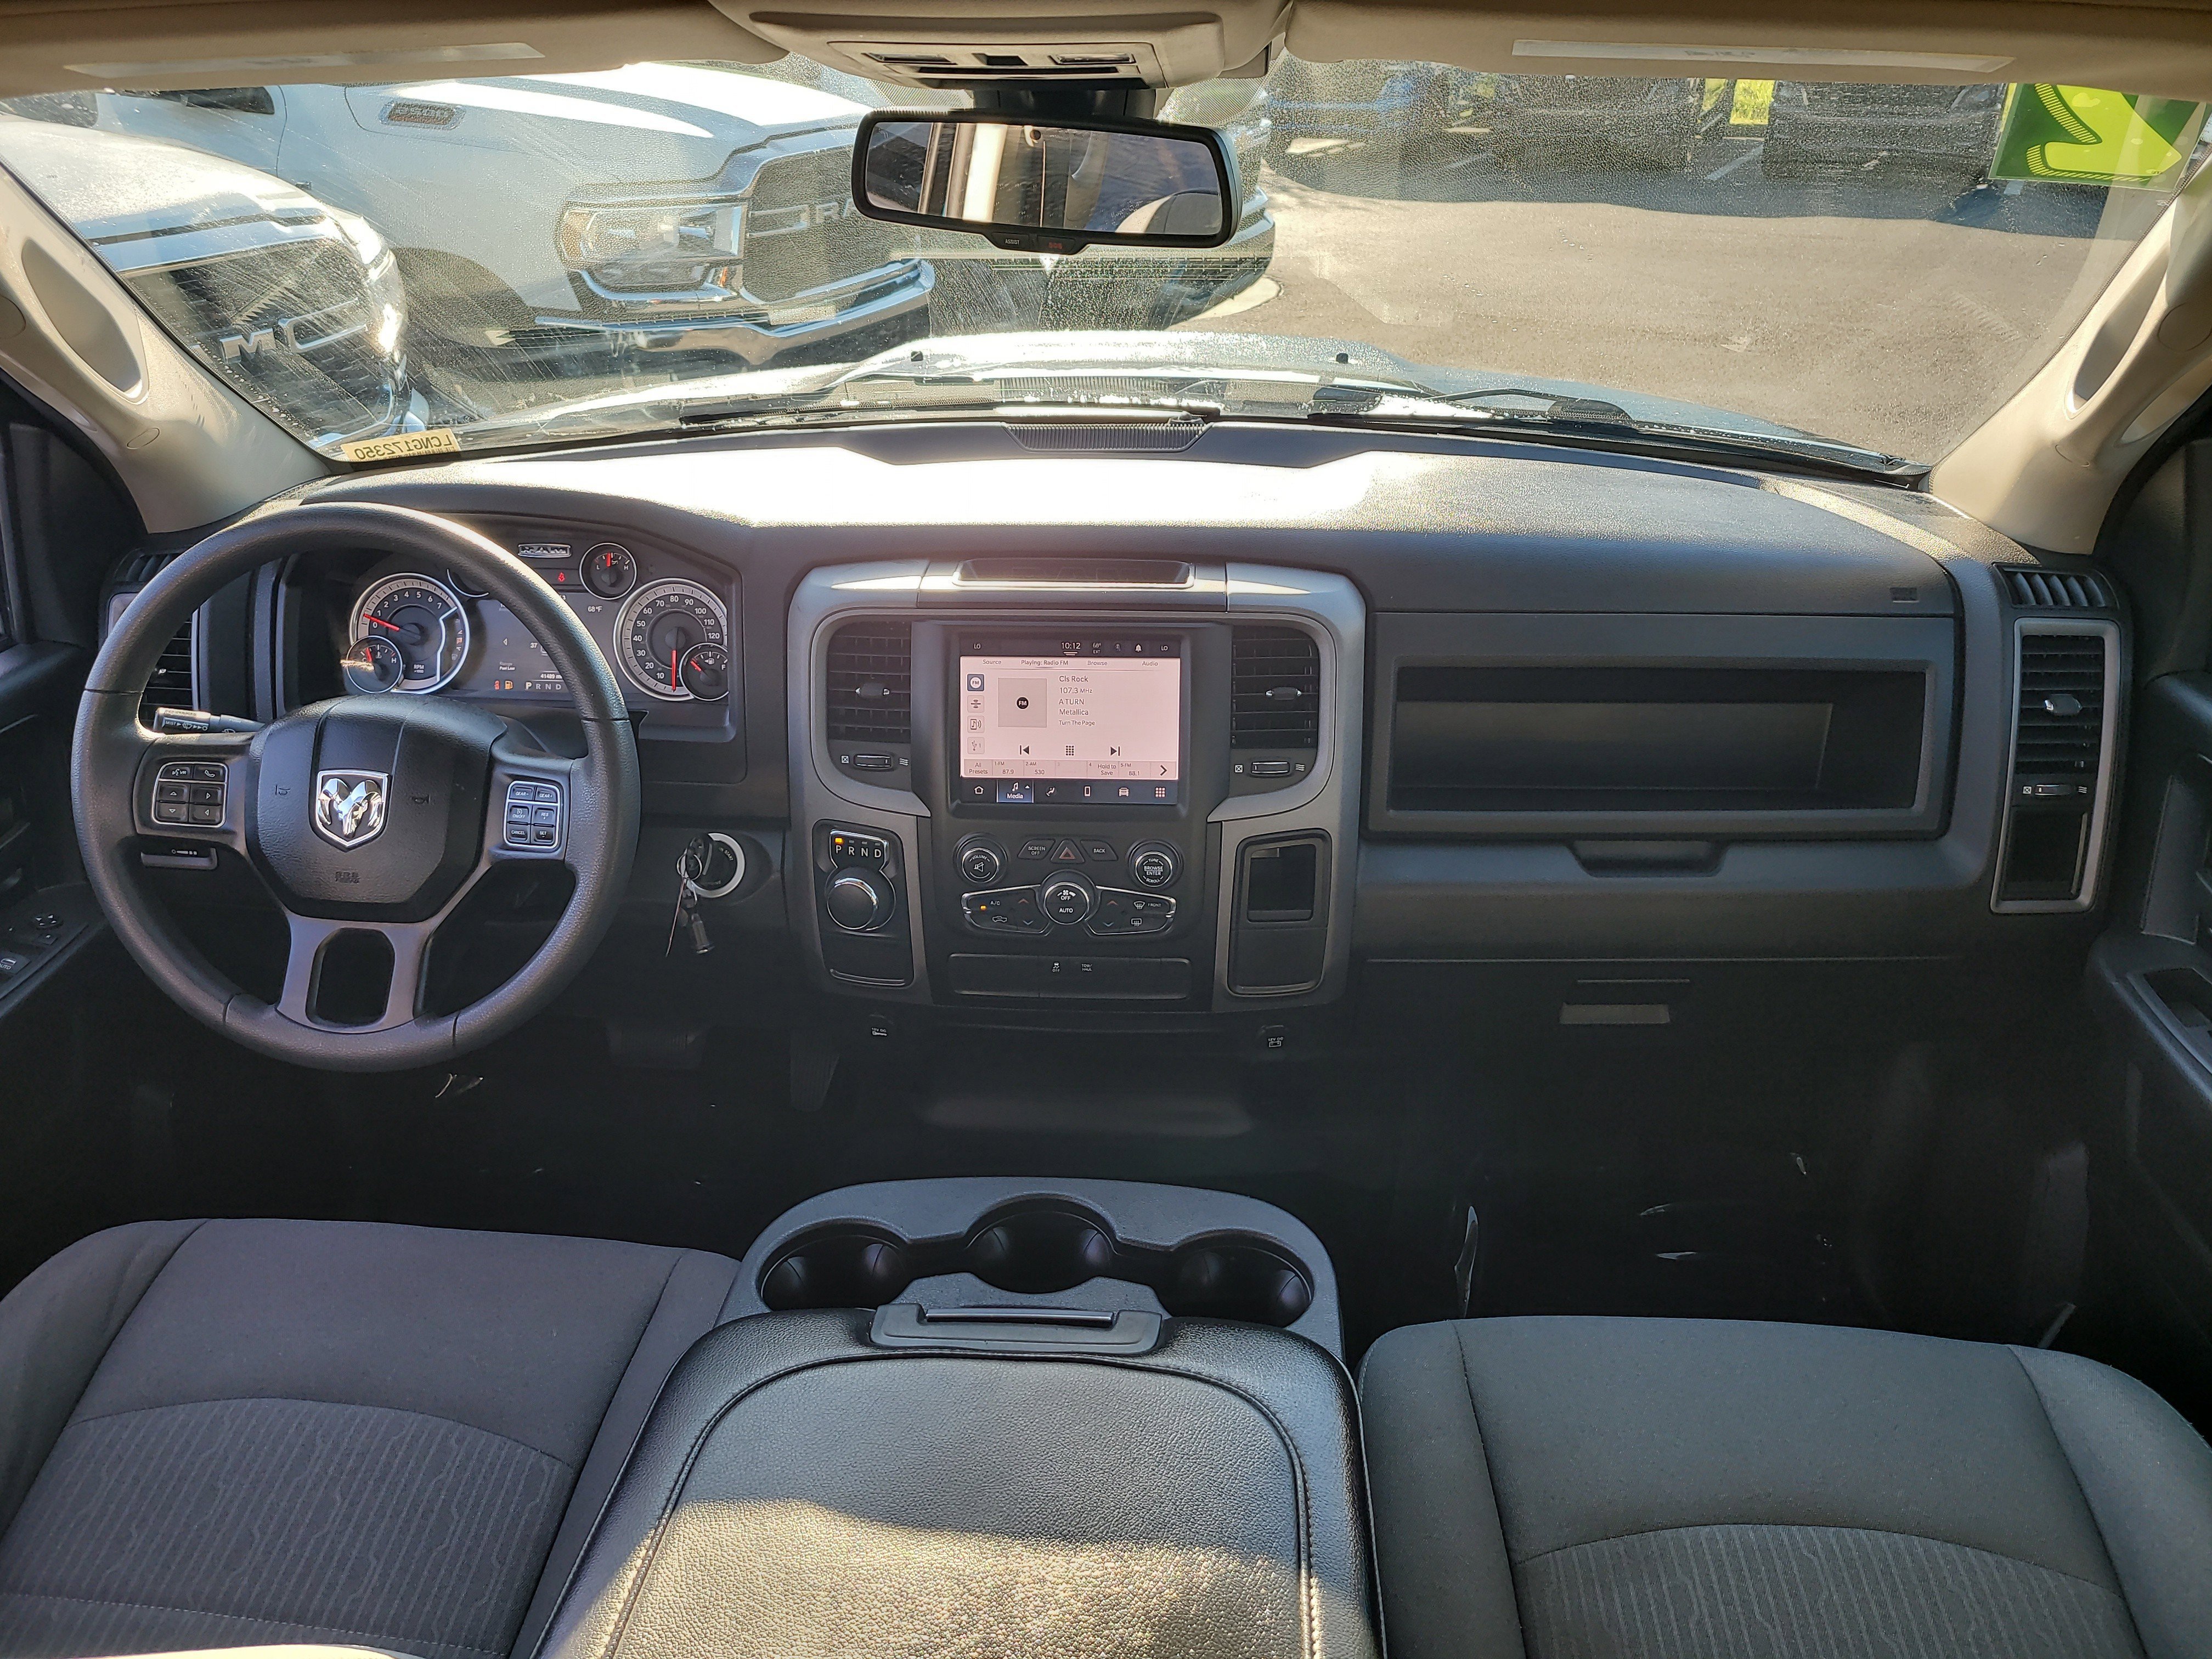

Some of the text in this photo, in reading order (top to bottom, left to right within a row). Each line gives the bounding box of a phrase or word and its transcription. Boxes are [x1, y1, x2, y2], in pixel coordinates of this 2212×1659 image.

[526, 682, 533, 691] P
[836, 845, 881, 858] P R N D
